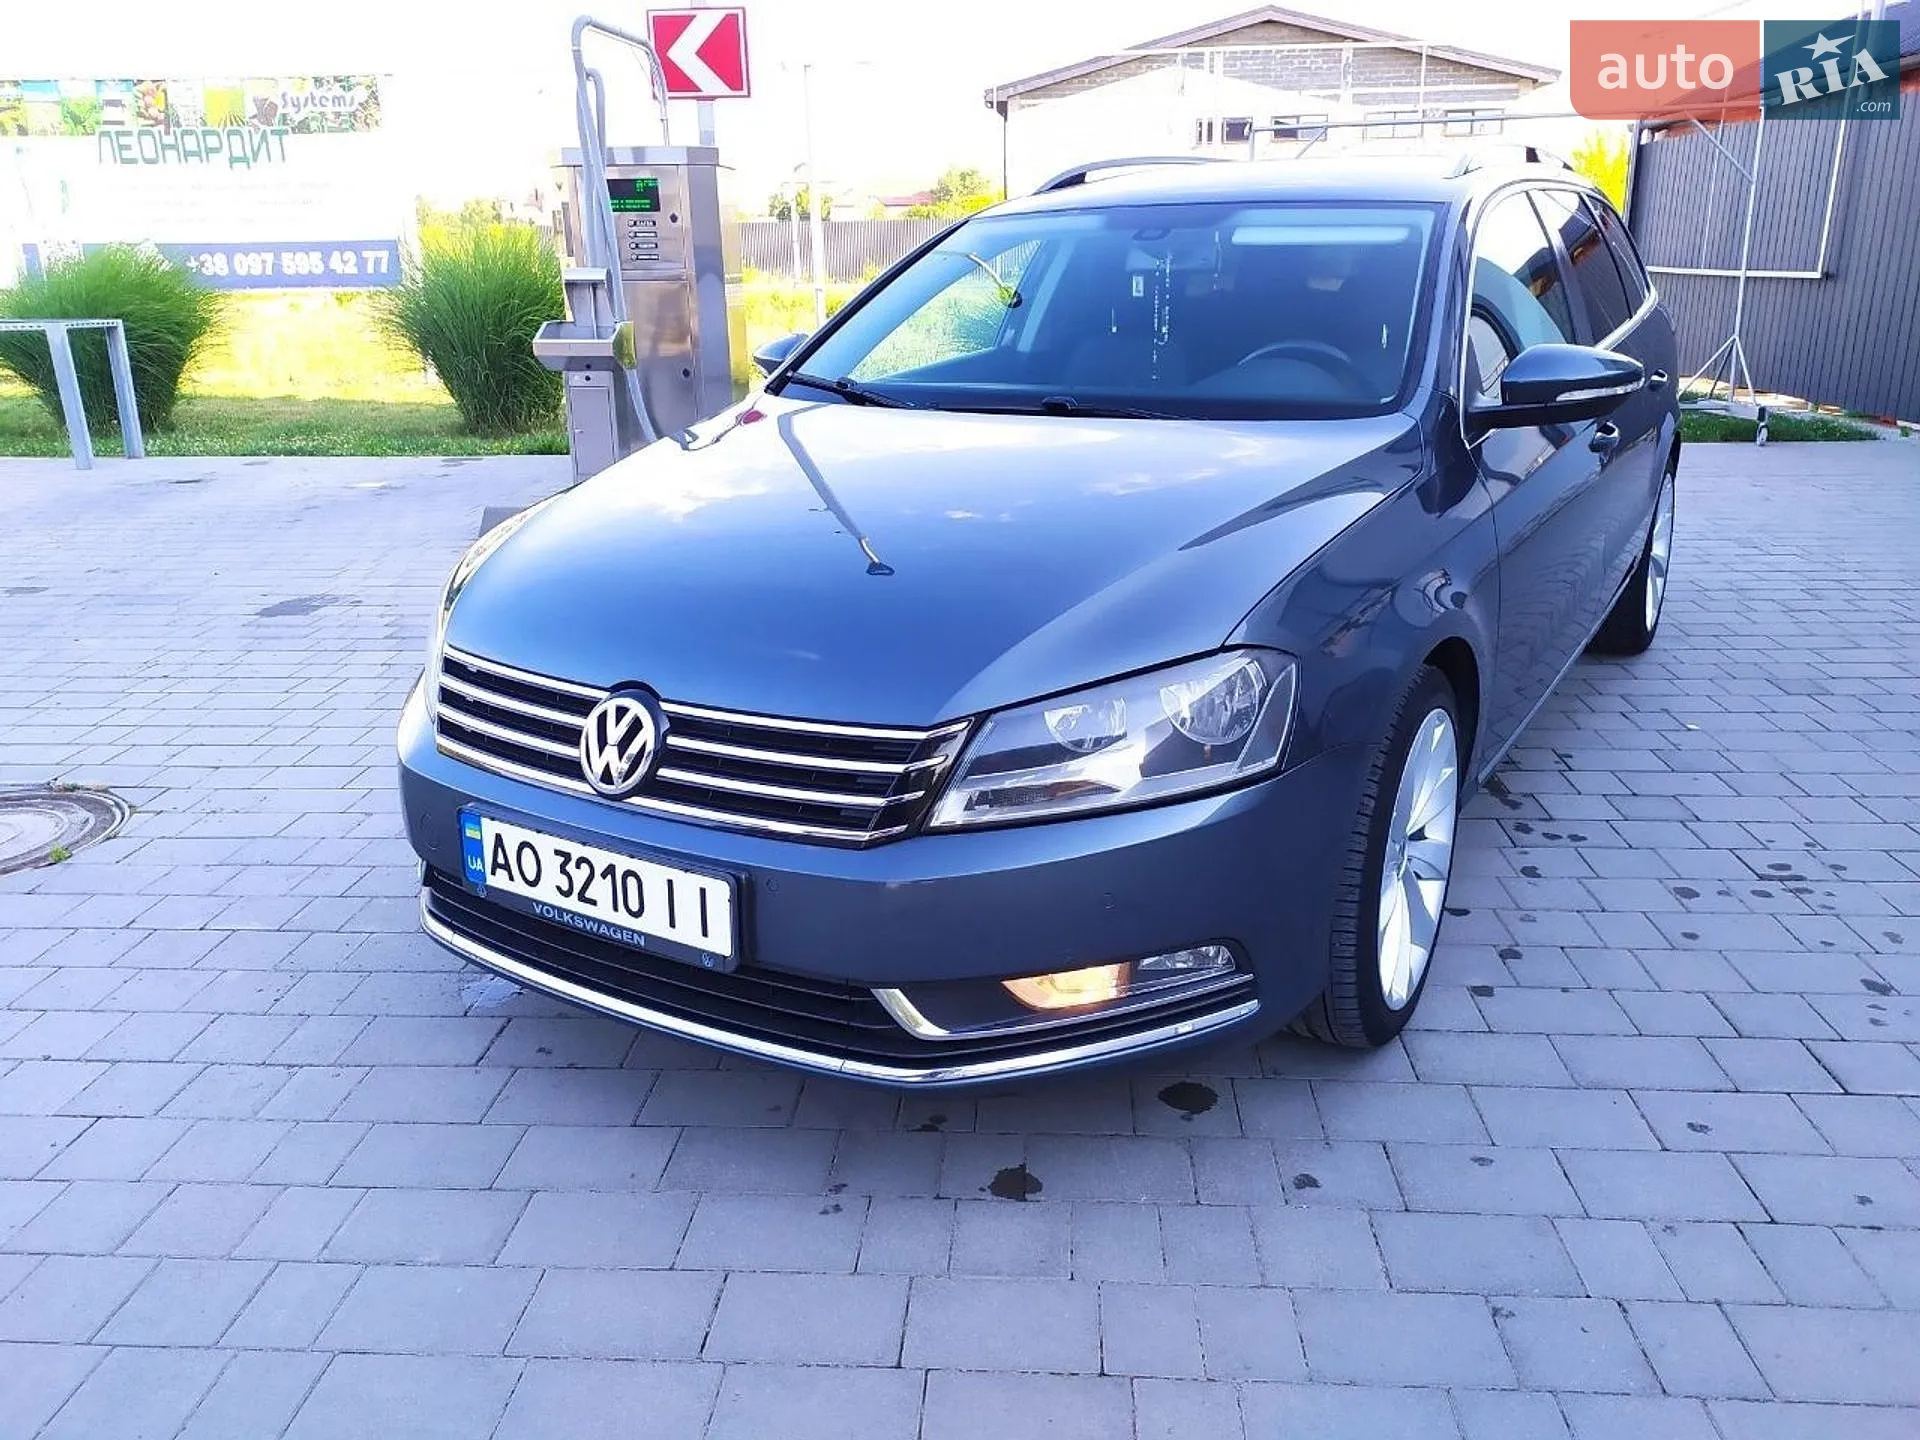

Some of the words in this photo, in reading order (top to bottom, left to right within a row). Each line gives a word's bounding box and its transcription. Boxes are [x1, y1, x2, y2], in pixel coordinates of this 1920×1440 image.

[98, 129, 289, 169] ЛЕОНАРДИТ
[233, 252, 275, 276] 097
[328, 251, 358, 274] 42
[362, 250, 390, 274] 77
[467, 855, 484, 872] UA
[490, 832, 542, 888] AO
[553, 848, 645, 919] 3210
[532, 901, 645, 947] VOLKSWAGEN
